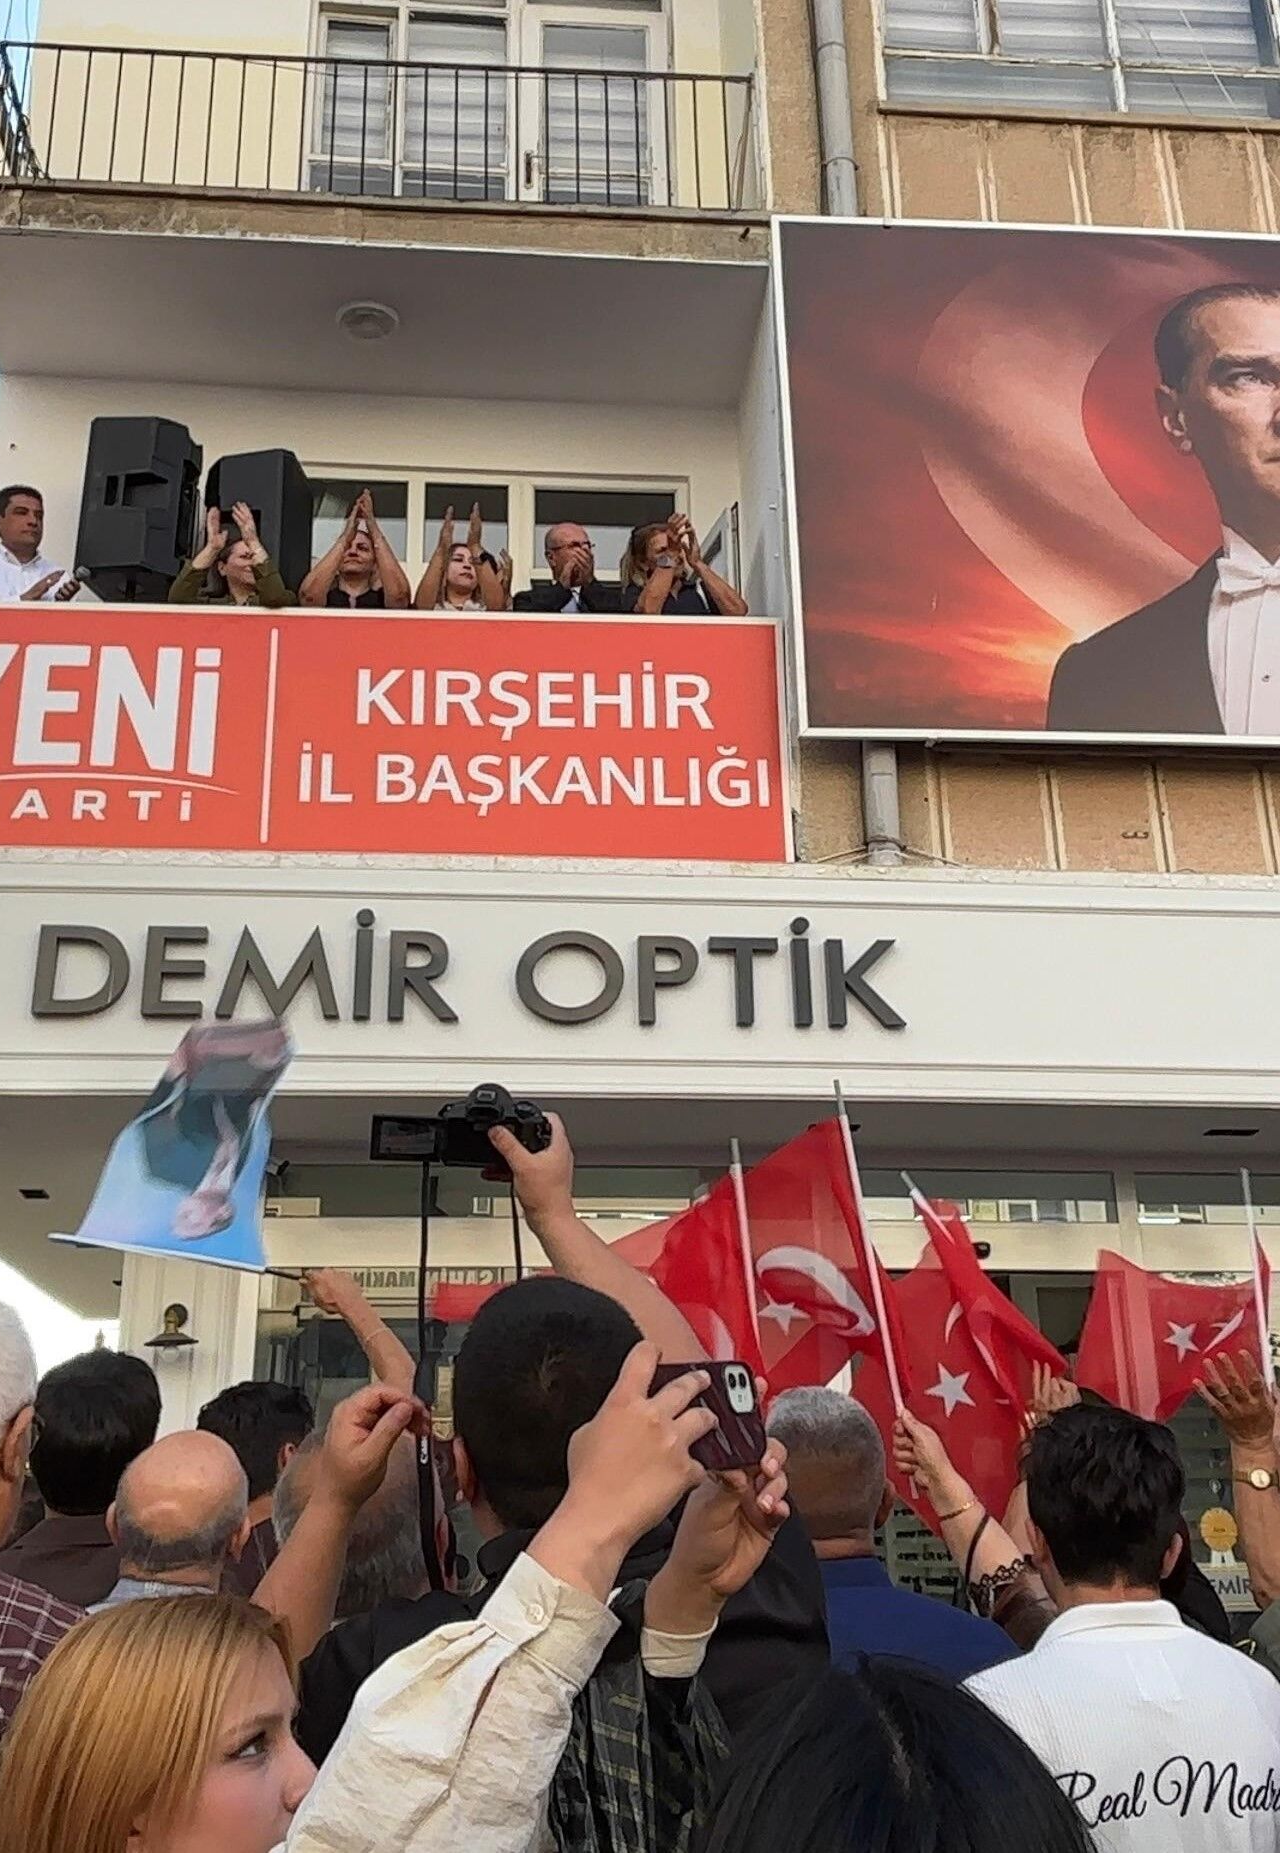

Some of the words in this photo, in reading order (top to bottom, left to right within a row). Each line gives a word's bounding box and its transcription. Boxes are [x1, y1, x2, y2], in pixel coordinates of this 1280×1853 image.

[356, 661, 714, 741] KIRŞEHİR
[299, 742, 353, 803] İL
[376, 746, 770, 816] BAŞKANLIĞI
[31, 908, 459, 1024] DEMİR
[516, 916, 907, 1031] OPTİK
[1056, 1770, 1147, 1829] Real
